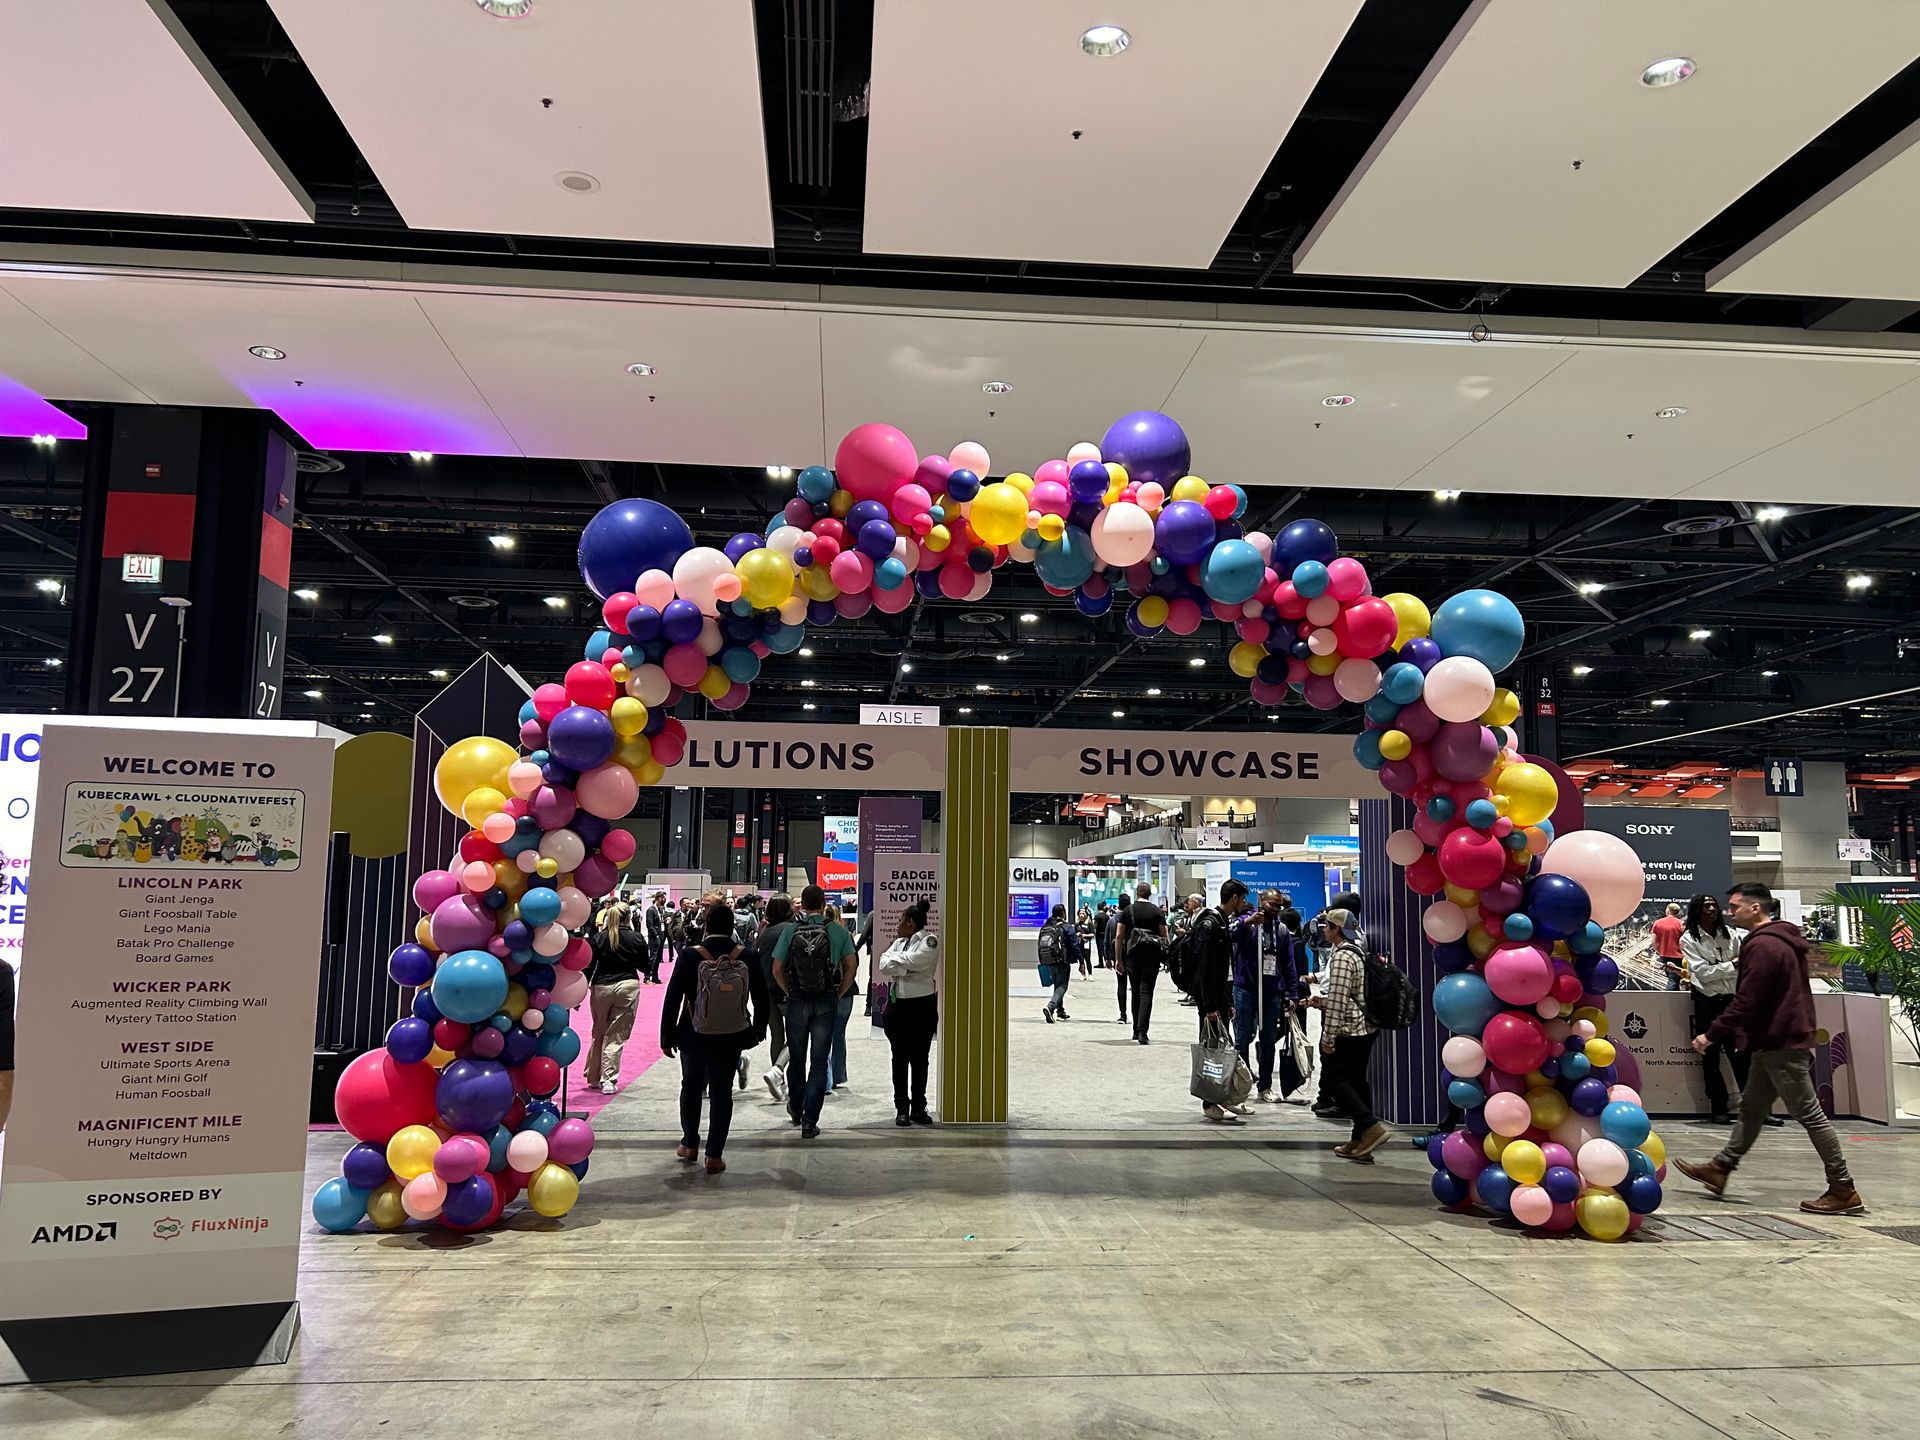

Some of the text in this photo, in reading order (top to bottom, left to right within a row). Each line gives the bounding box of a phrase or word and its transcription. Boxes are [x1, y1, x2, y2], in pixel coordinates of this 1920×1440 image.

[128, 556, 154, 574] EXIT
[125, 613, 157, 650] V
[266, 631, 278, 668] V
[109, 667, 164, 703] 27
[1542, 678, 1548, 686] R
[256, 681, 277, 718] 27
[1540, 688, 1552, 698] 32
[876, 710, 923, 724] AISLE
[666, 739, 875, 771] LUTIONS
[103, 756, 276, 779] WELCOME TO
[1079, 747, 1320, 780] SHOWCASE
[77, 789, 162, 802] KUBECRAWL
[175, 793, 297, 806] CLOUDNATIVEFEST
[1625, 824, 1676, 835] SONY
[1648, 862, 1672, 870] every
[1674, 861, 1696, 870] layer
[892, 871, 935, 880] BADGE
[1013, 867, 1059, 882] GitLab
[118, 877, 243, 890] LINCOLN PARK
[880, 882, 940, 891] SCANNIN
[145, 894, 214, 906] Giant Jenga
[889, 893, 937, 902] NOTICE
[119, 909, 237, 919] Giant Foosball Table
[144, 924, 211, 935] Lego Mania
[117, 938, 235, 950] Batak Pro Challenge
[136, 953, 214, 963] Board Games
[112, 981, 232, 993] WICKER PARK
[71, 997, 267, 1010] Augmented Reality Climbing Wall
[105, 1013, 237, 1025] Mystery Tattoo Station
[121, 1041, 214, 1054] WEST SIDE
[100, 1058, 230, 1070] Ultimate Sports Arena
[121, 1073, 208, 1085] Giant Mini Golf
[116, 1088, 211, 1100] Human Foosball
[77, 1115, 242, 1132] MAGNIFICENT MILE
[87, 1133, 230, 1148] Hungry Hungry Humans
[129, 1150, 188, 1161] Meltdown
[86, 1188, 222, 1206] SPONSORED BY
[191, 1216, 269, 1233] FluxNinja
[31, 1224, 94, 1244] AMD
